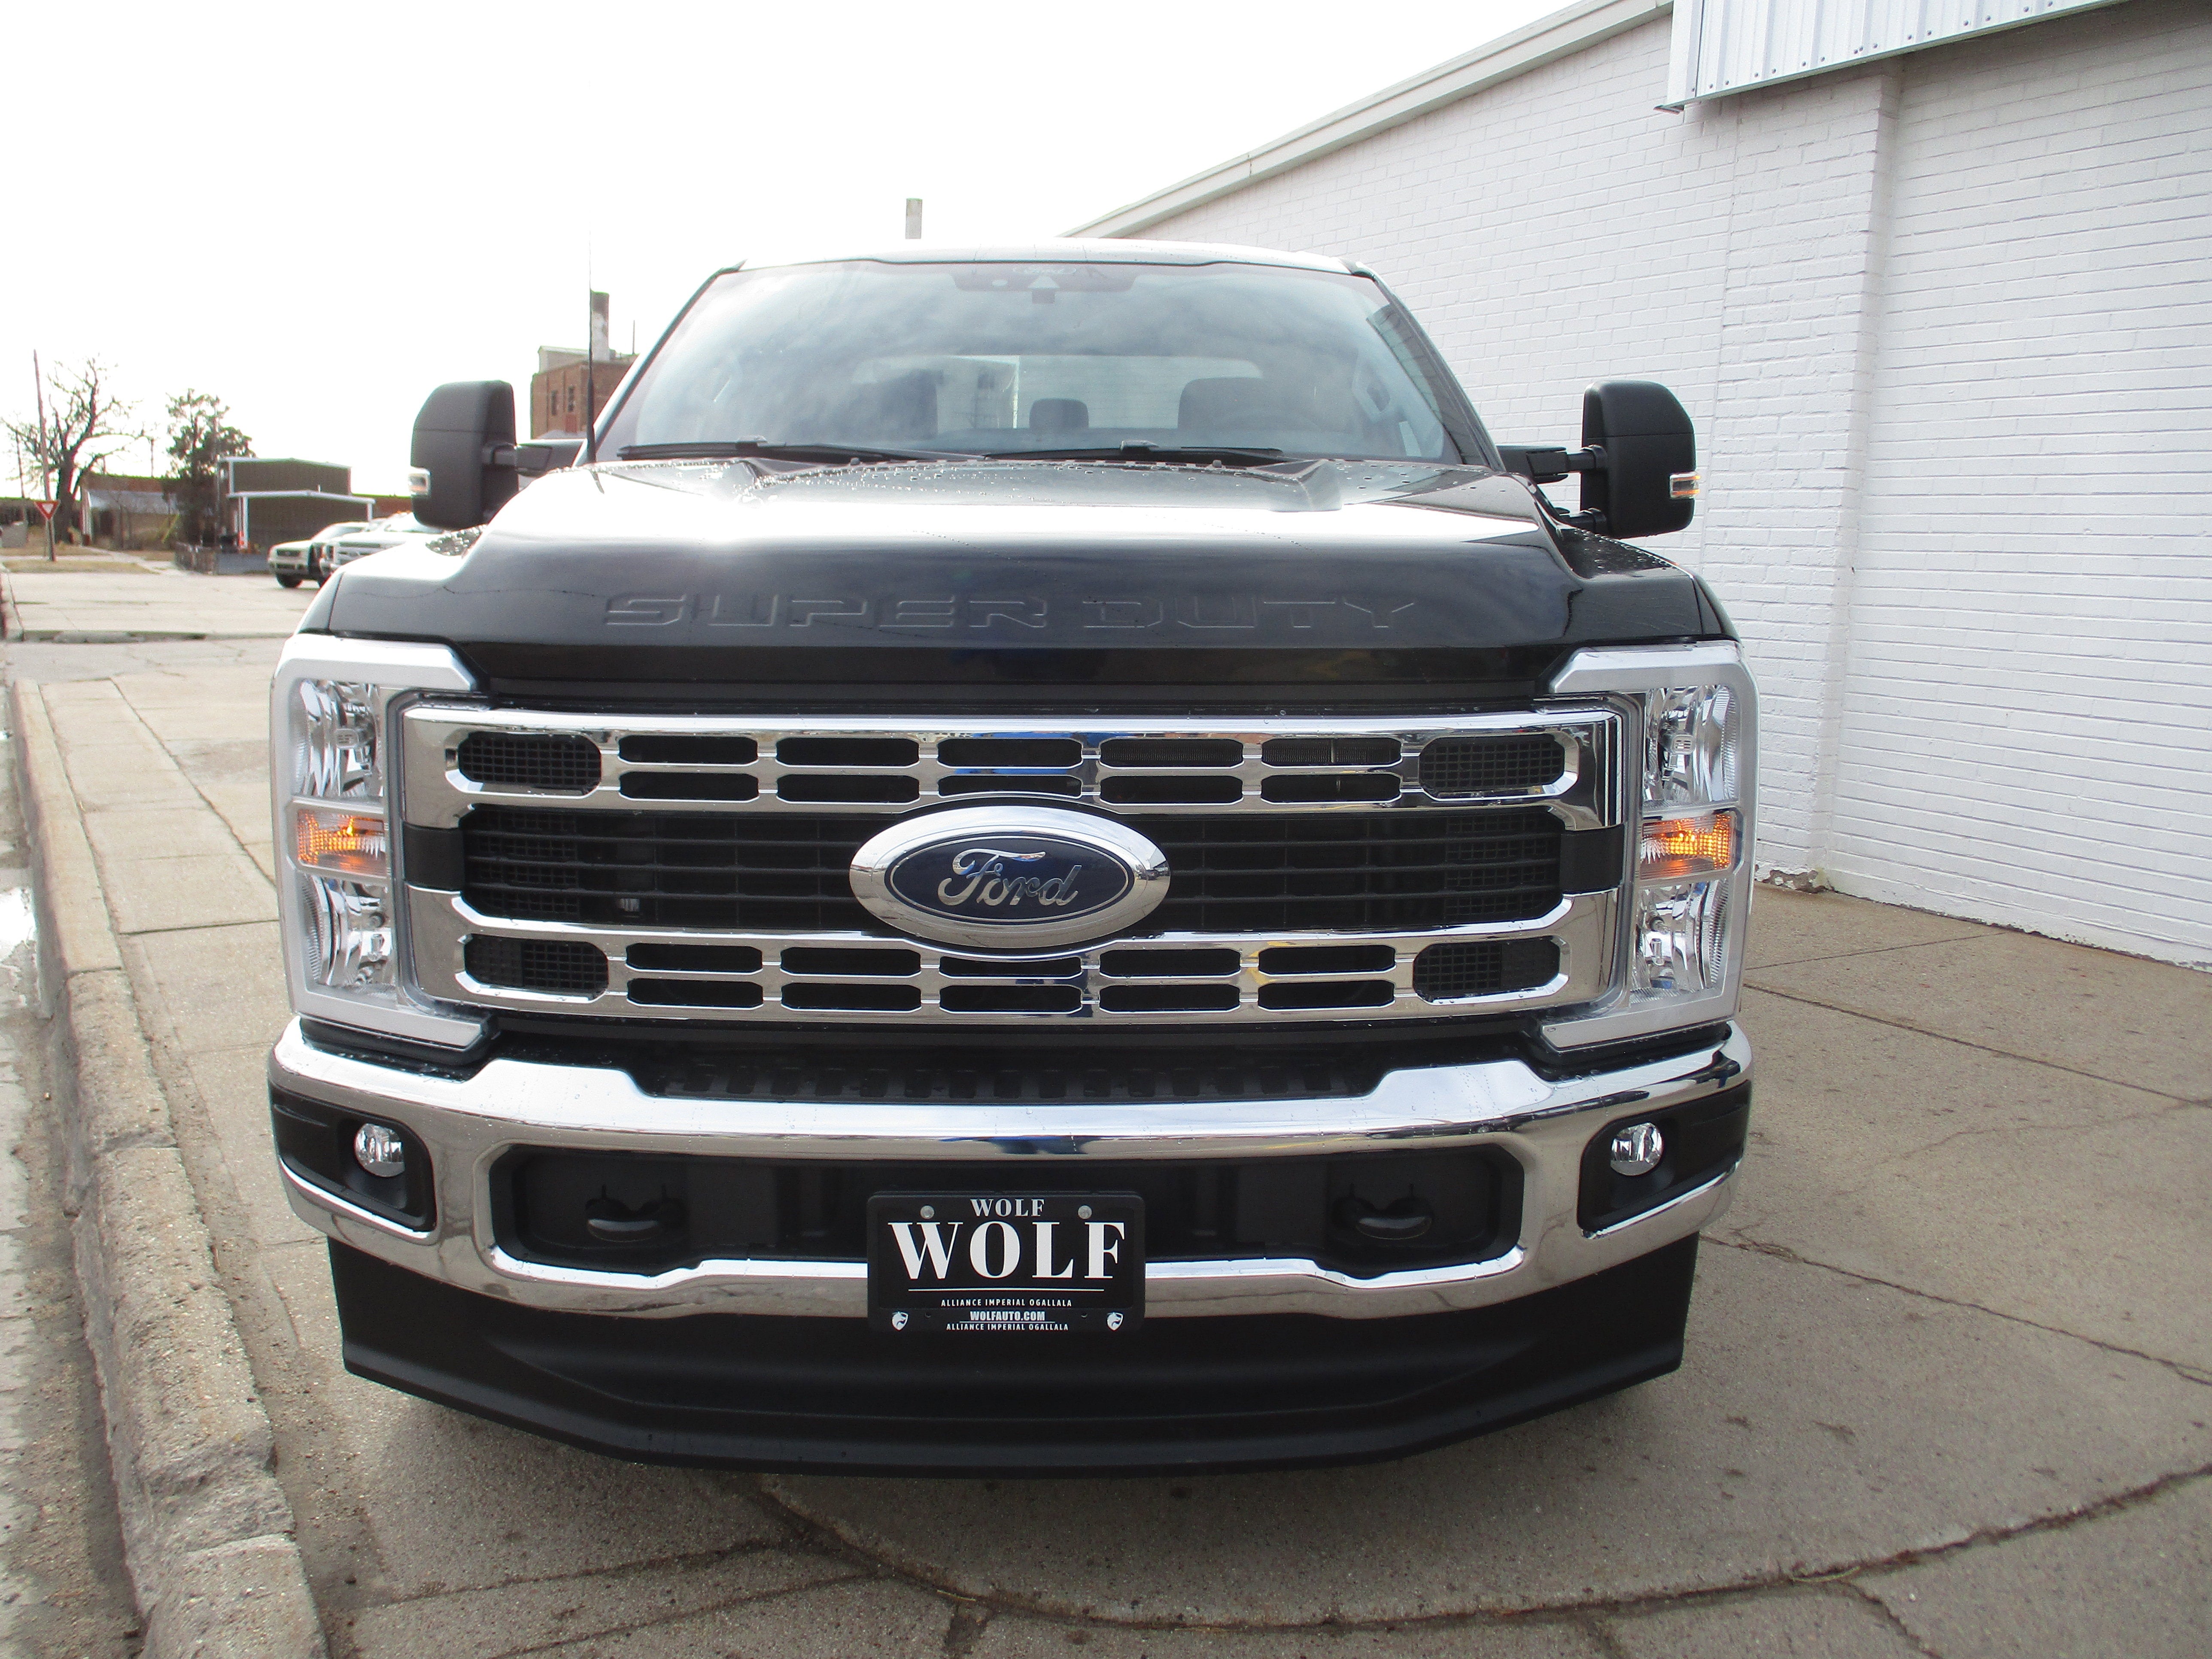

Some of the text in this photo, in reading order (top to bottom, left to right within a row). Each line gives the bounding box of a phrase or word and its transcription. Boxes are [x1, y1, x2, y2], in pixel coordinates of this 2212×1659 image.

[605, 591, 1416, 629] SUPER DUTY
[938, 848, 1082, 906] Ford
[969, 1198, 1045, 1217] WOLF
[887, 1221, 1125, 1280] WOLF
[940, 1298, 1072, 1307] ALLIANCE IMPERIAL OGALLALA
[969, 1310, 1045, 1321] WOLFAUTO.COM
[946, 1323, 1069, 1331] ALLIANCE IMPERIAL OGALLALA
